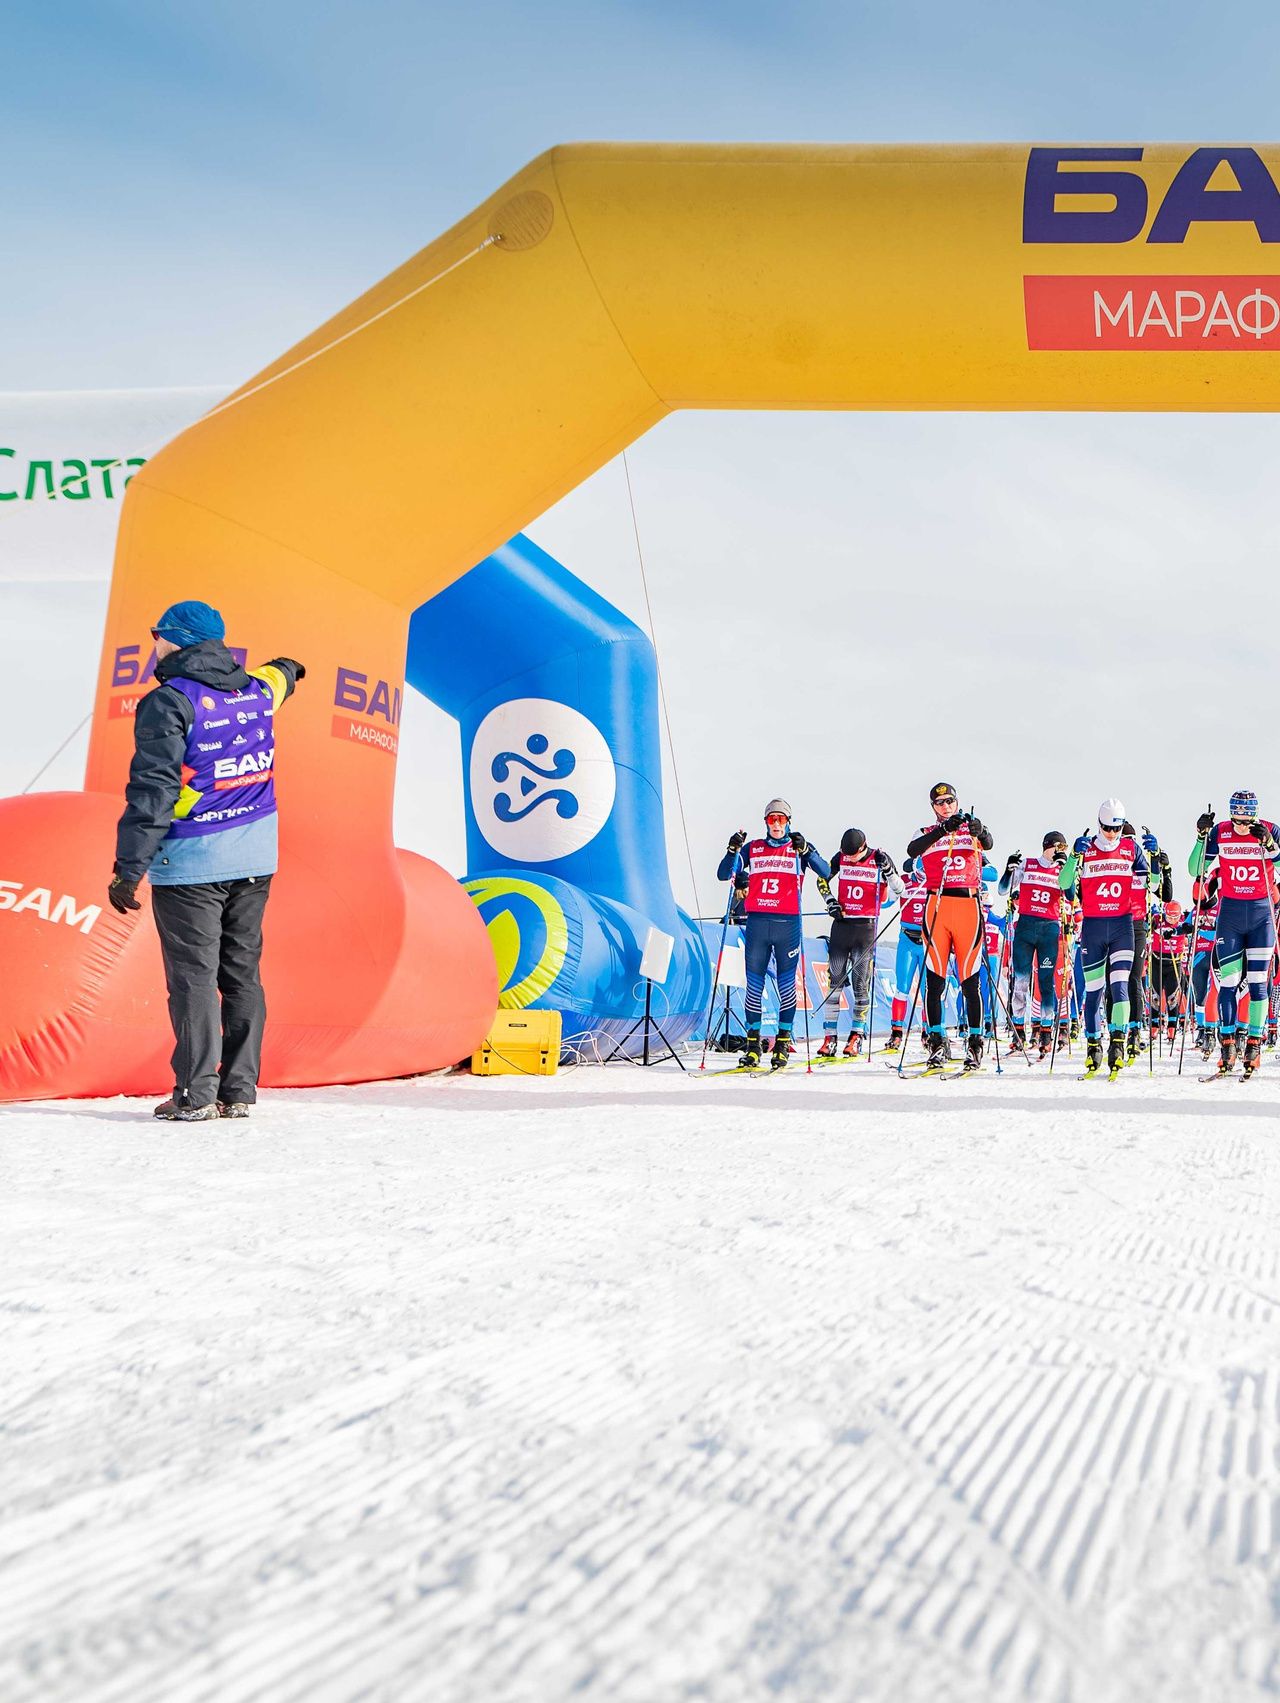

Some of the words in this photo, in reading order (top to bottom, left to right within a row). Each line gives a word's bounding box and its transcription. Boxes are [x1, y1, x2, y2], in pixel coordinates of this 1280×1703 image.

[214, 748, 275, 779] БАМ
[941, 855, 966, 870] 29
[1229, 865, 1260, 882] 102
[761, 878, 780, 894] 13
[846, 885, 864, 900] 10
[1096, 882, 1122, 898] 40
[1030, 889, 1051, 904] 38
[912, 903, 926, 914] 9
